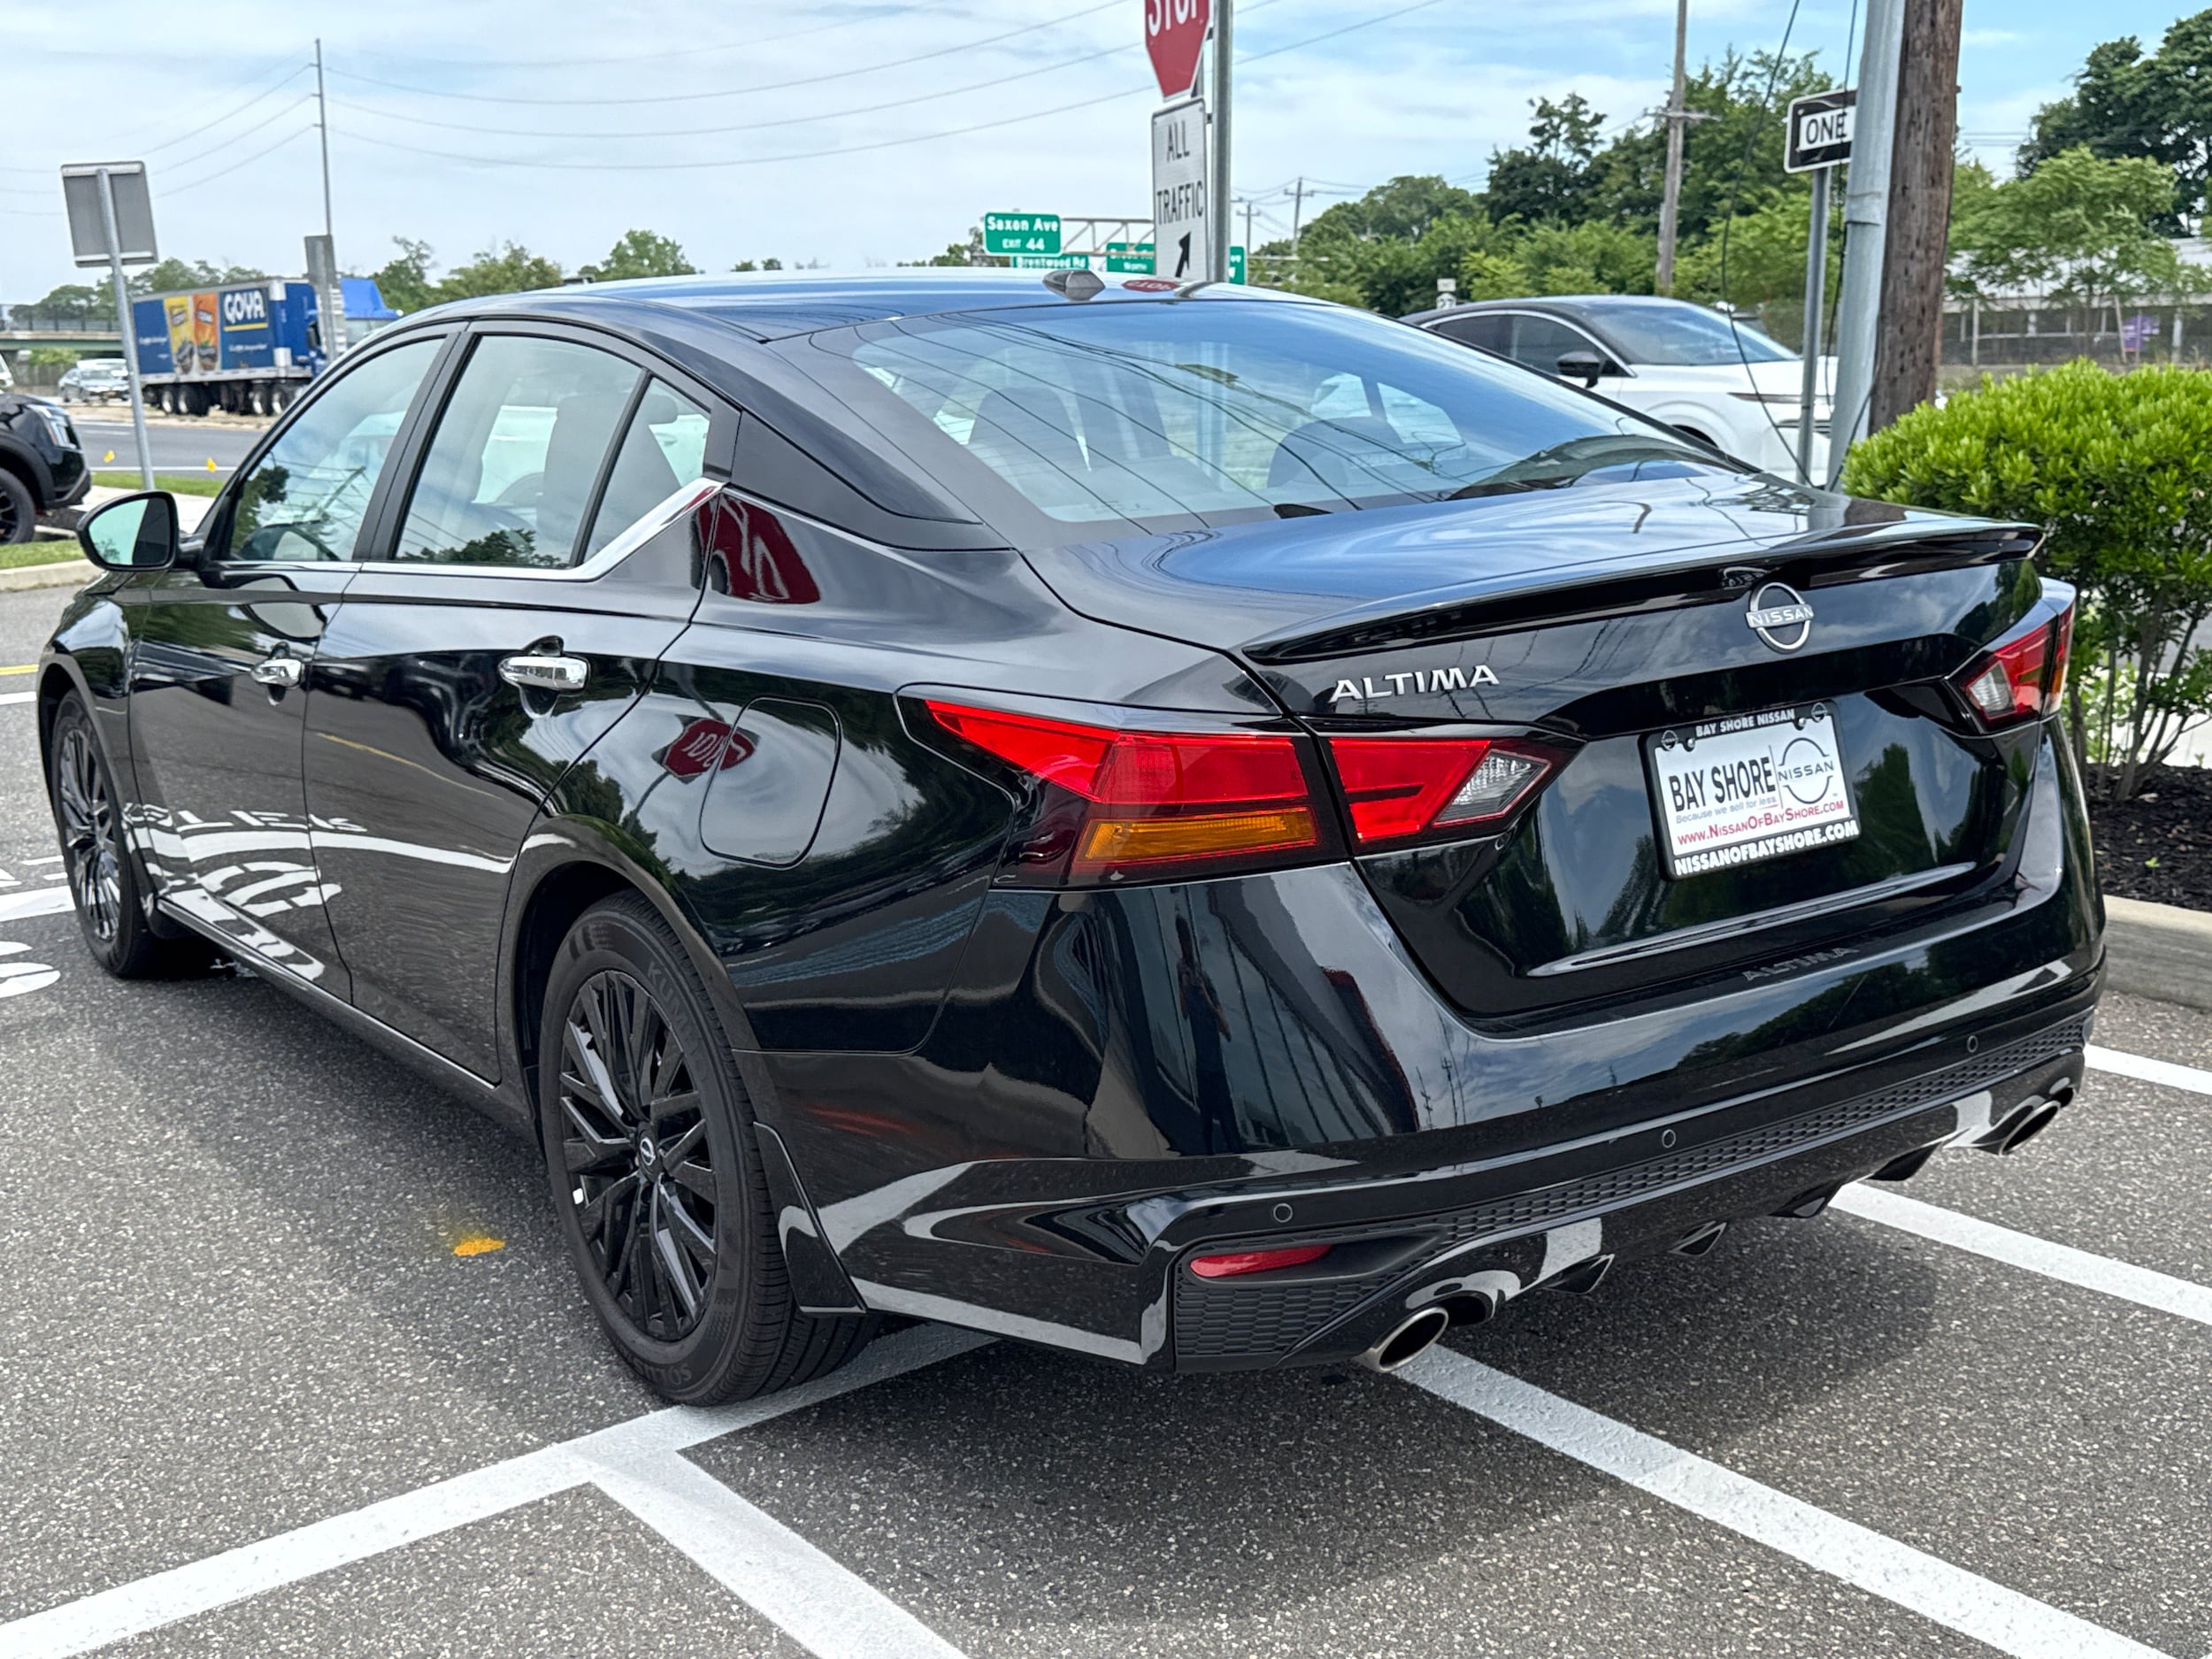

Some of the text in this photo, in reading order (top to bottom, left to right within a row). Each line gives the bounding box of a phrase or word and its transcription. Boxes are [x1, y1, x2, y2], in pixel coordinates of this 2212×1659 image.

[1167, 120, 1190, 162] ALL
[1806, 111, 1847, 144] ONE
[1156, 180, 1203, 225] TRAFFIC
[987, 216, 1059, 232] Saxon Ave
[1025, 237, 1045, 250] 44
[224, 290, 265, 325] GOYA
[1748, 606, 1814, 625] NISSAN
[1327, 664, 1501, 703] ALTIMA
[1695, 724, 1717, 737] BAY
[1720, 718, 1755, 733] SHORE
[1756, 709, 1795, 726] NISSAN
[1669, 757, 1776, 812] BAY SHORE
[1778, 760, 1835, 782] NISSAN
[1676, 810, 1712, 824] Because
[1714, 806, 1728, 815] we
[1729, 802, 1744, 812] sell
[1673, 820, 1859, 876] NISSANOFBAYSHORE.COM
